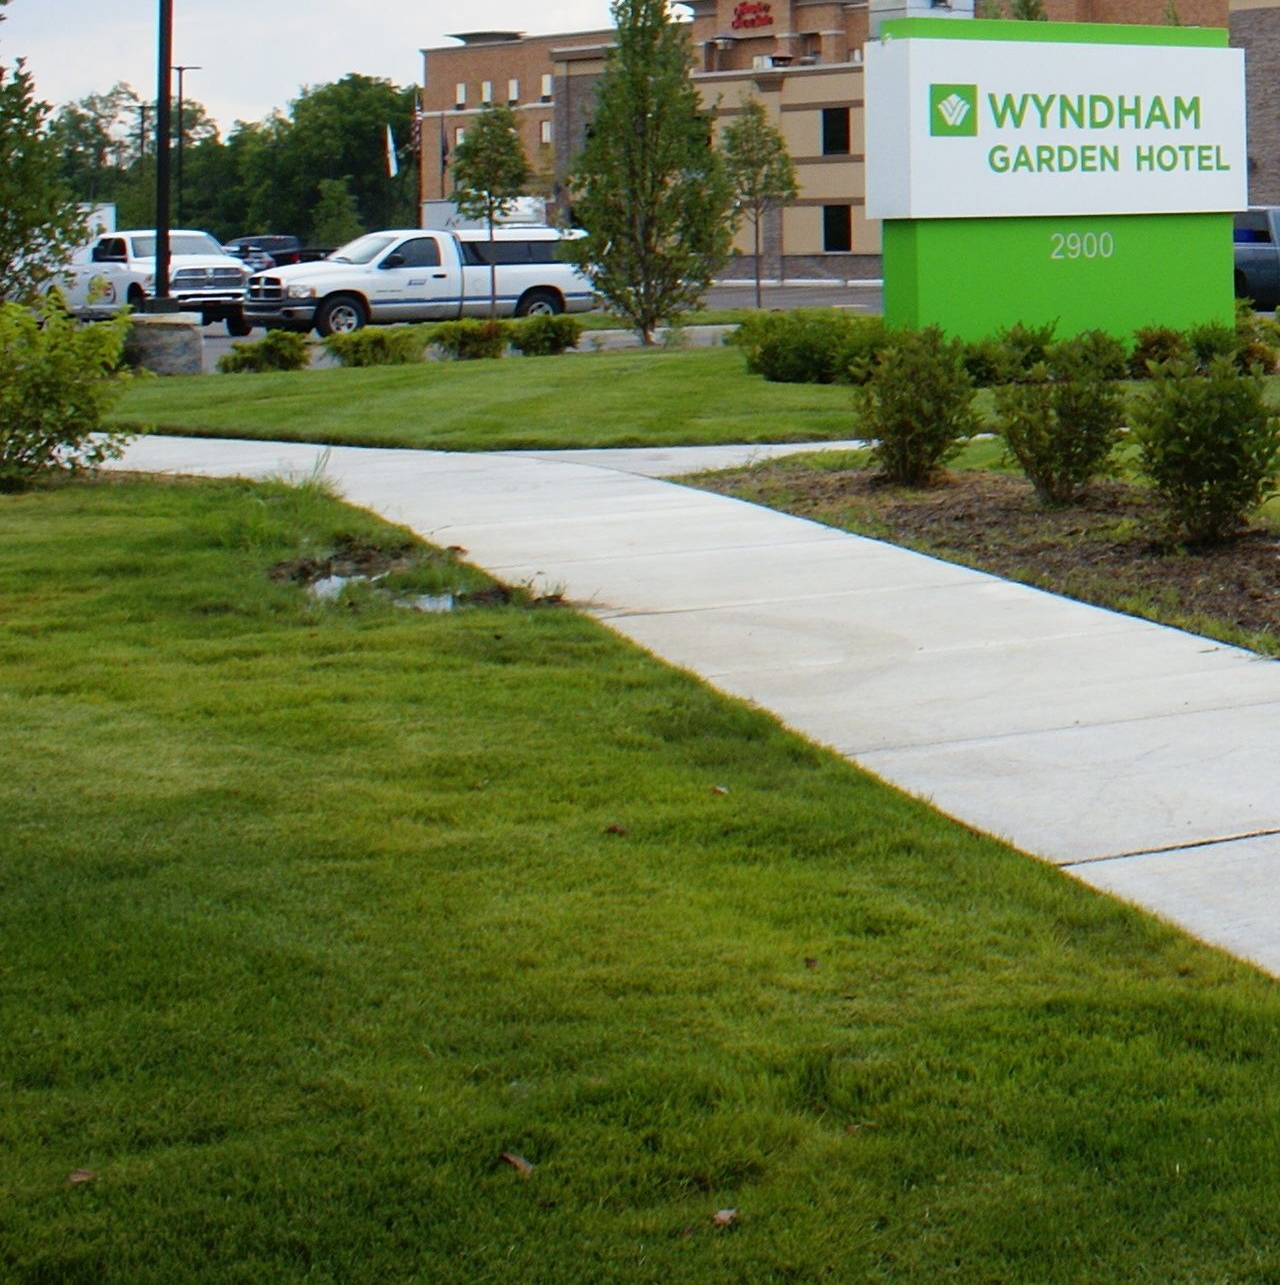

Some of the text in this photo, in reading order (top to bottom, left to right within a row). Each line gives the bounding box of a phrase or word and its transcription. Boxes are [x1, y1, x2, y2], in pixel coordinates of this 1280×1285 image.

[988, 93, 1201, 129] WYNDHAM
[988, 145, 1231, 173] GARDEN HOTEL
[1051, 232, 1114, 259] 2900
